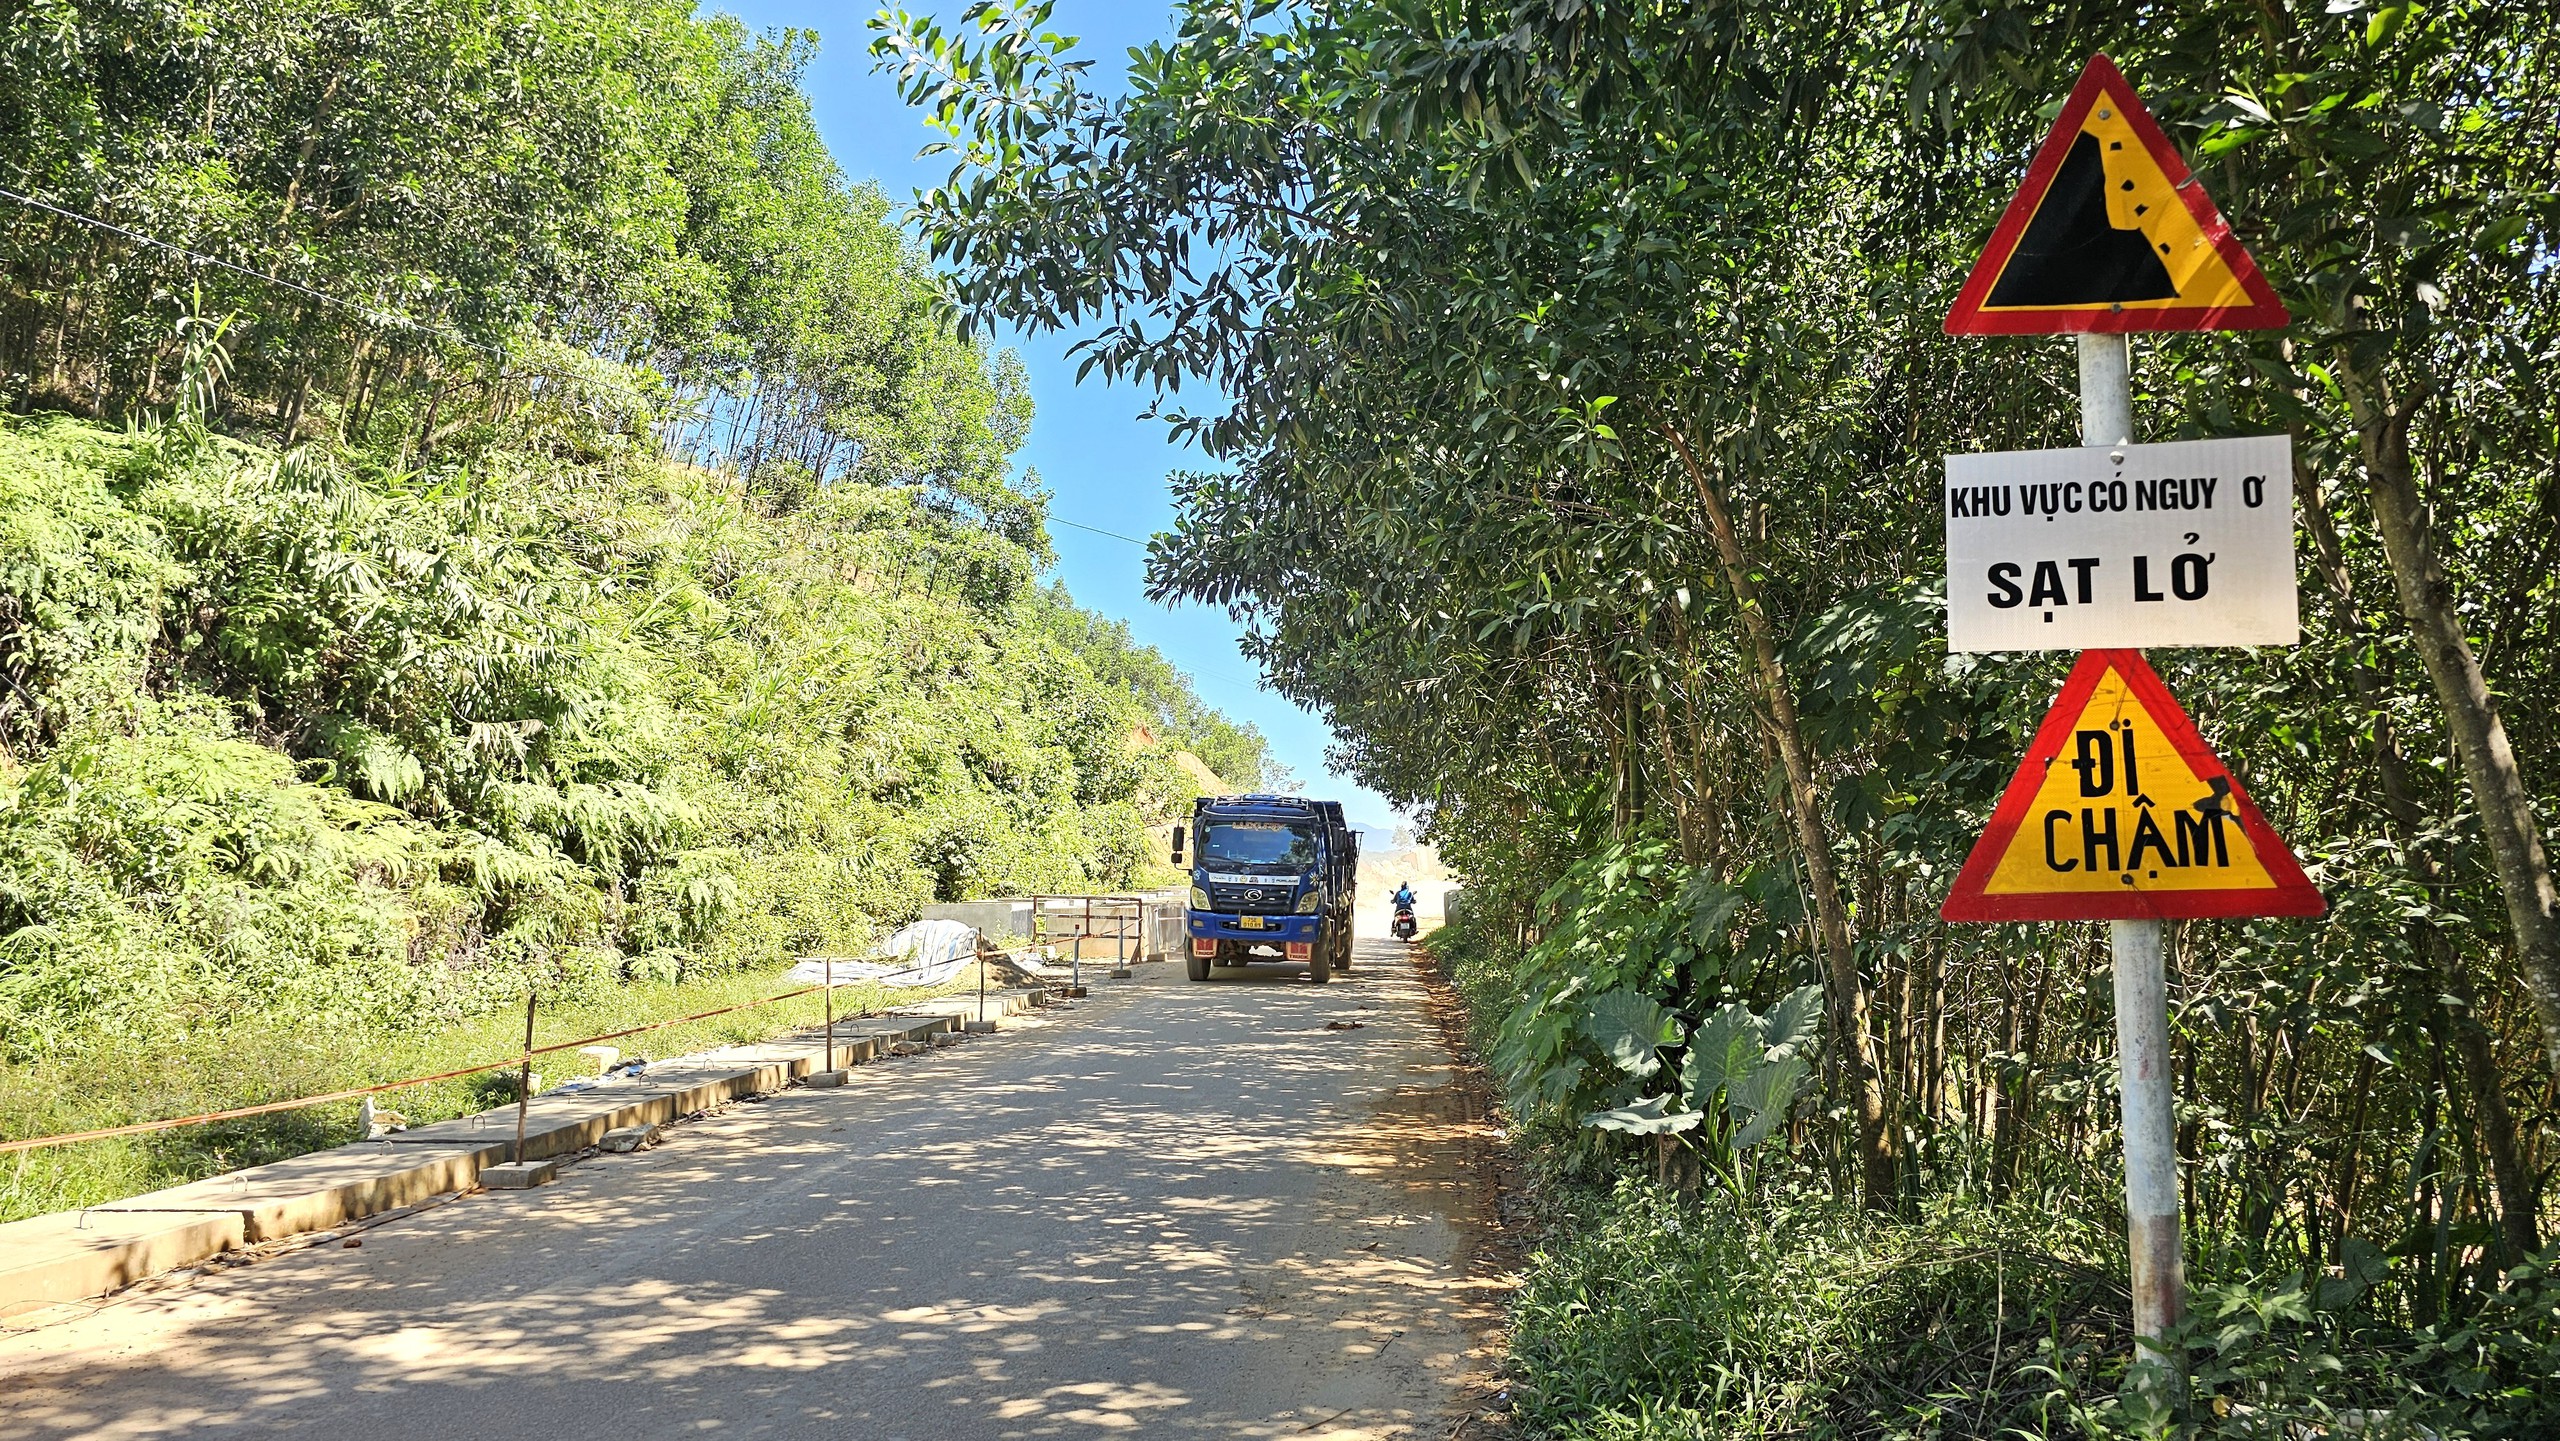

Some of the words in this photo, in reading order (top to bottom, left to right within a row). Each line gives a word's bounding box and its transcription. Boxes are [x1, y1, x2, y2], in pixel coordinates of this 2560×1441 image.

[1951, 484, 2011, 518] KHU
[2019, 481, 2082, 521] VỰC
[2088, 471, 2128, 513] CÓ
[2136, 477, 2218, 511] NGUY
[1987, 557, 2100, 623] SẠT
[2133, 532, 2216, 602] LỞ
[2043, 792, 2230, 878] CHẬM
